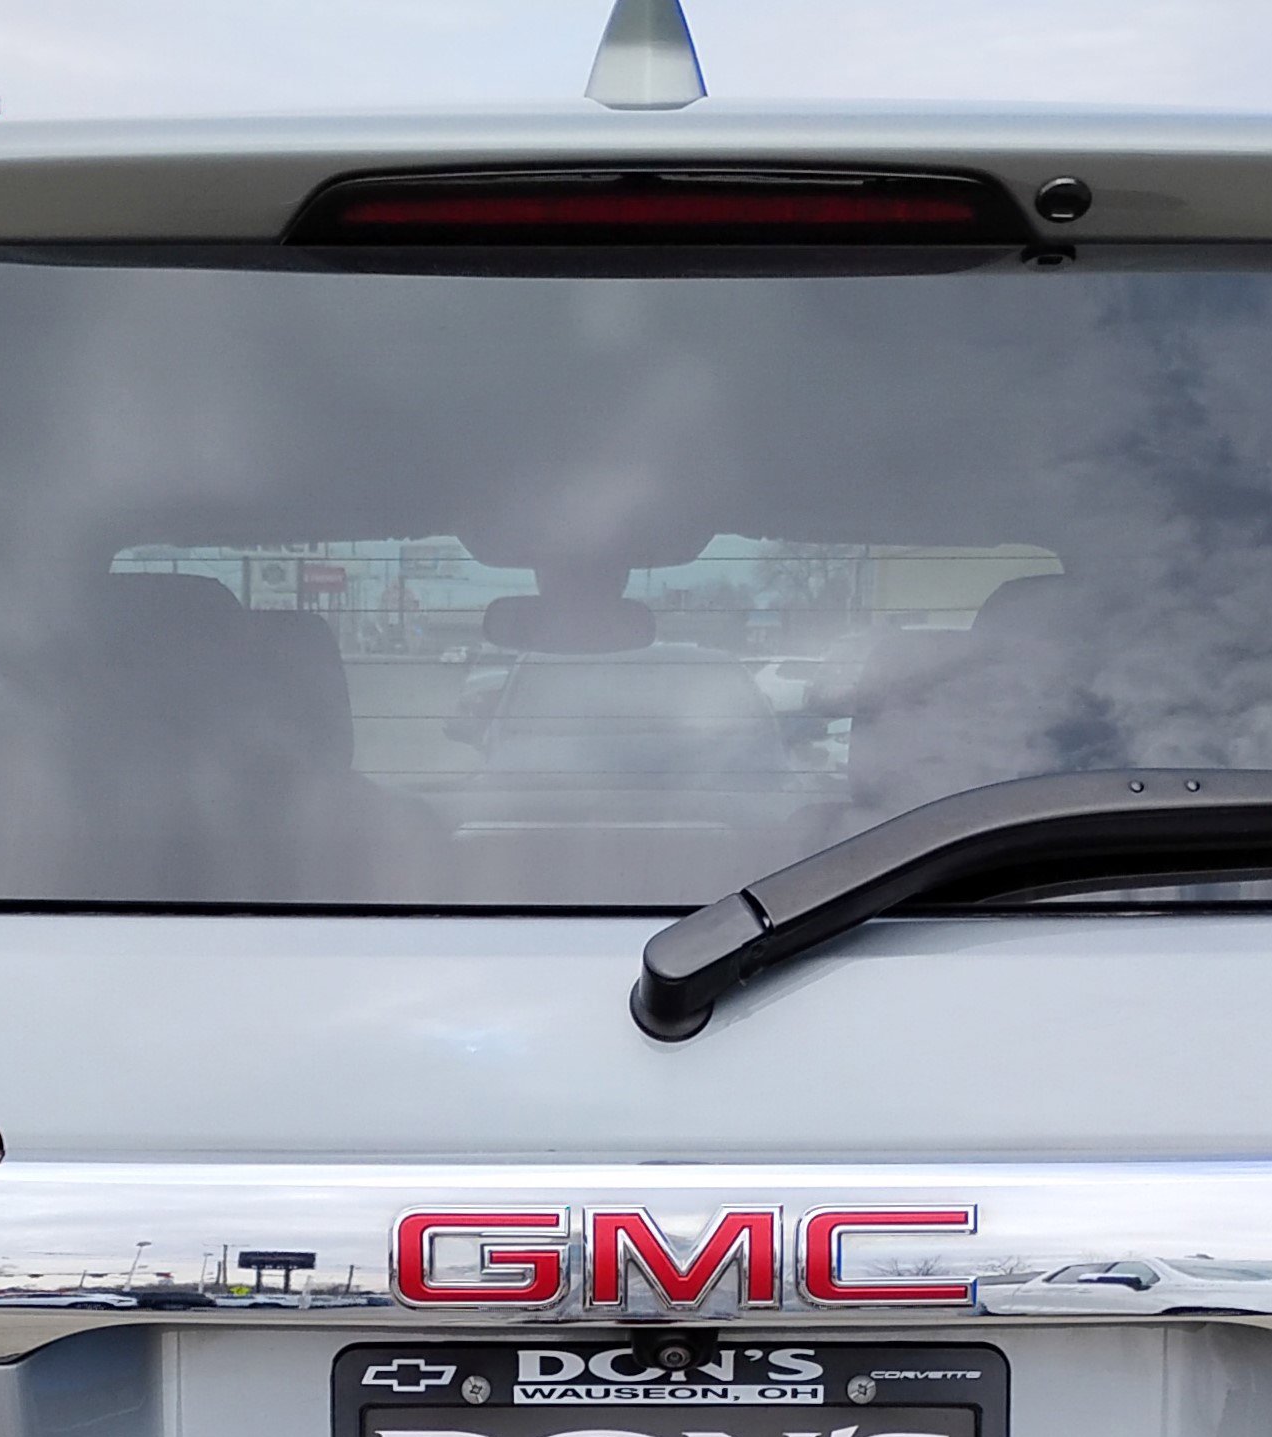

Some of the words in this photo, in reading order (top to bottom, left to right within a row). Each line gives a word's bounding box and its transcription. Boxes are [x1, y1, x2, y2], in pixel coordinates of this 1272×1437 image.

[389, 1204, 978, 1312] GMC
[517, 1349, 824, 1383] DON'S
[870, 1369, 982, 1381] CORVETTE
[520, 1386, 741, 1401] WAUSEON,
[758, 1387, 819, 1399] OH
